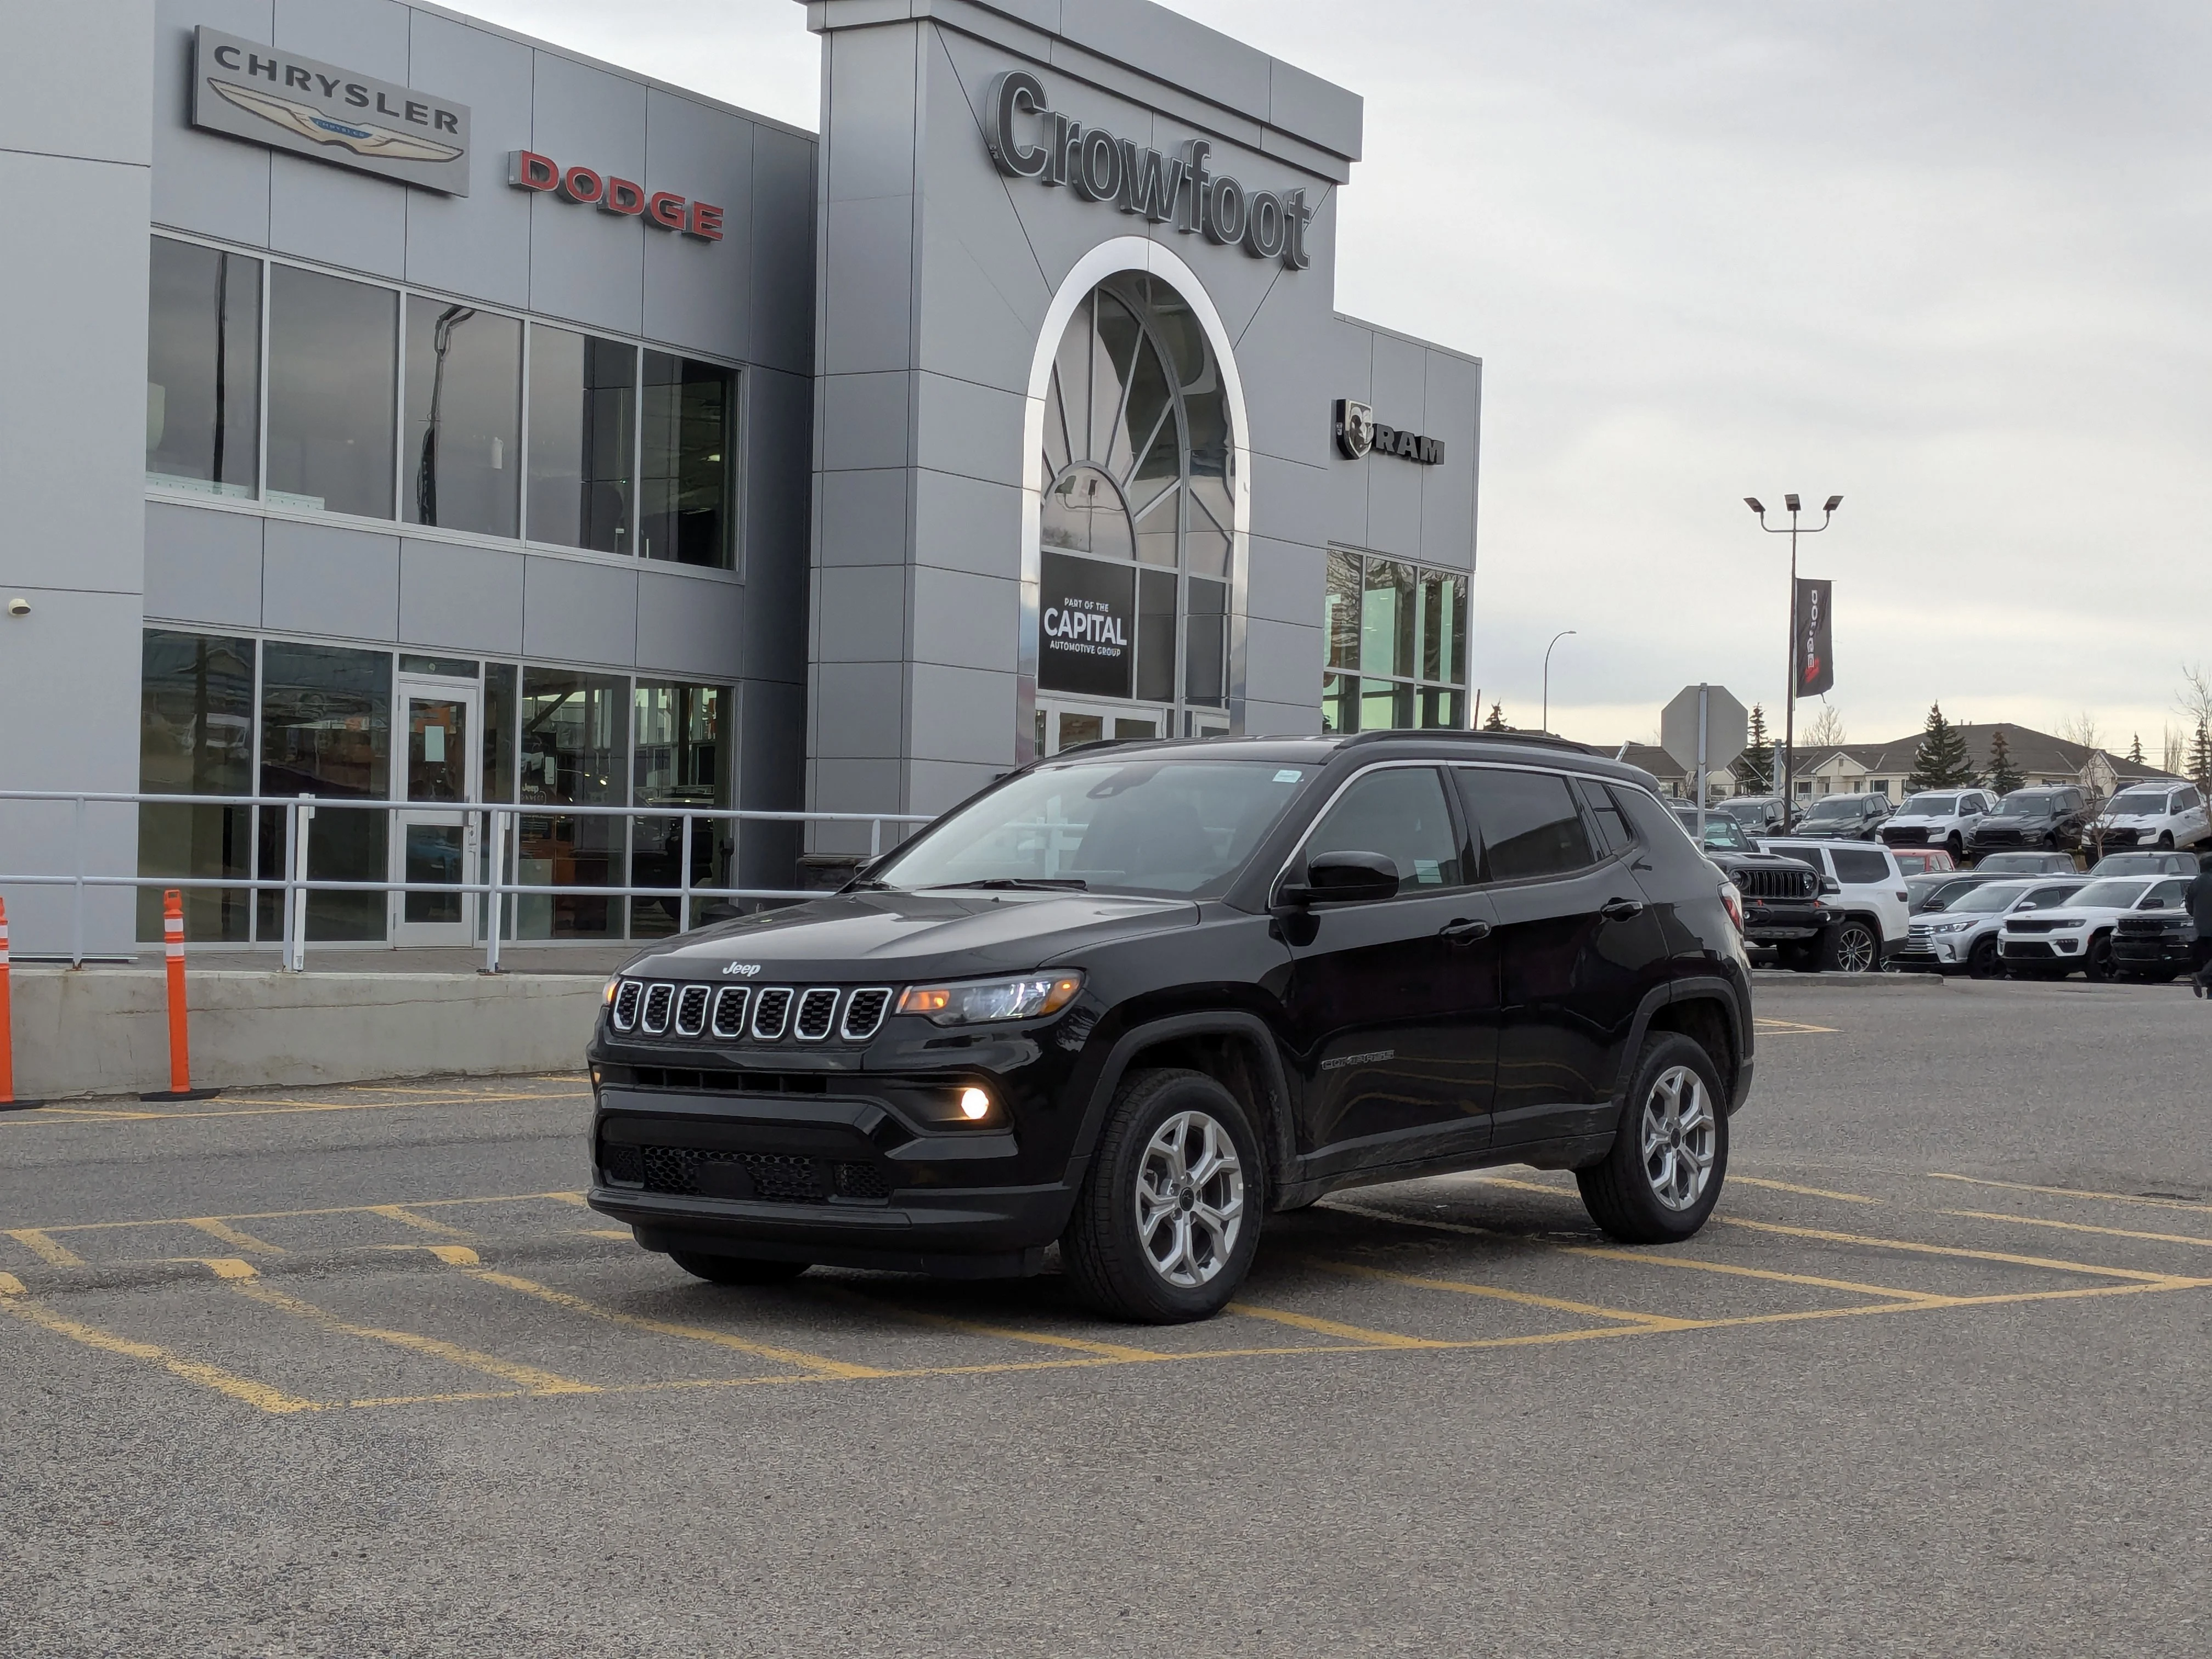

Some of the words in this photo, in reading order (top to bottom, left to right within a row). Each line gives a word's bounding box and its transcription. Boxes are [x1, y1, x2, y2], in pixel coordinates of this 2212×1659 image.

[213, 44, 460, 136] CHRYSLER
[986, 70, 1312, 271] Crowfoot
[510, 149, 724, 242] DODGE
[1373, 424, 1445, 465] RAM
[1064, 597, 1083, 608] PART
[1084, 601, 1095, 610] OF
[1096, 602, 1109, 613] THE
[1043, 607, 1127, 646] CAPITAL
[1049, 640, 1096, 654] AUTOMOTIVE
[1097, 646, 1121, 657] GROUP
[722, 961, 761, 977] Jeep
